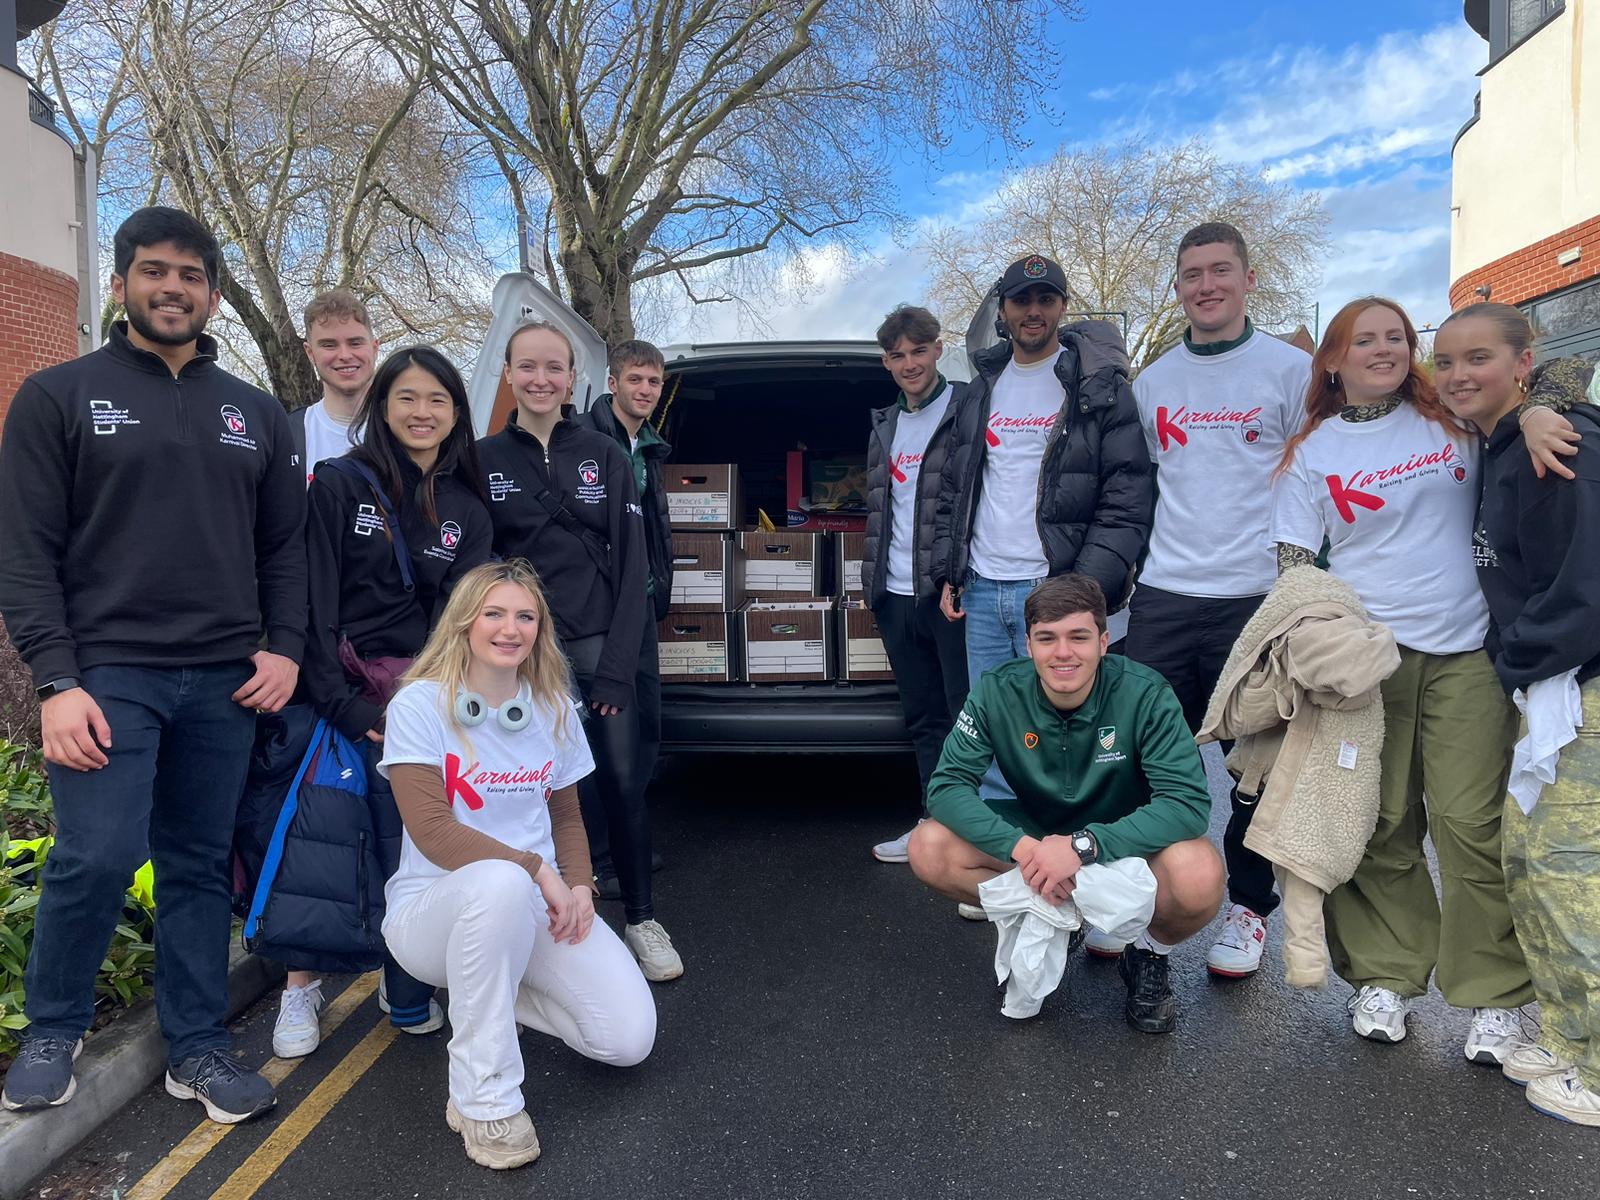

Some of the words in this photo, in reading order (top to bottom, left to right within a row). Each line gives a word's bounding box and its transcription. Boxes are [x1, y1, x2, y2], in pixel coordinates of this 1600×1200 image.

[1157, 405, 1262, 452] Karnival
[1325, 443, 1455, 524] Karnival
[1379, 478, 1402, 489] Raising
[1404, 473, 1417, 481] and
[1419, 468, 1439, 478] Giving
[445, 753, 553, 811] Karnival
[486, 786, 506, 794] Raising
[519, 785, 536, 793] Giving
